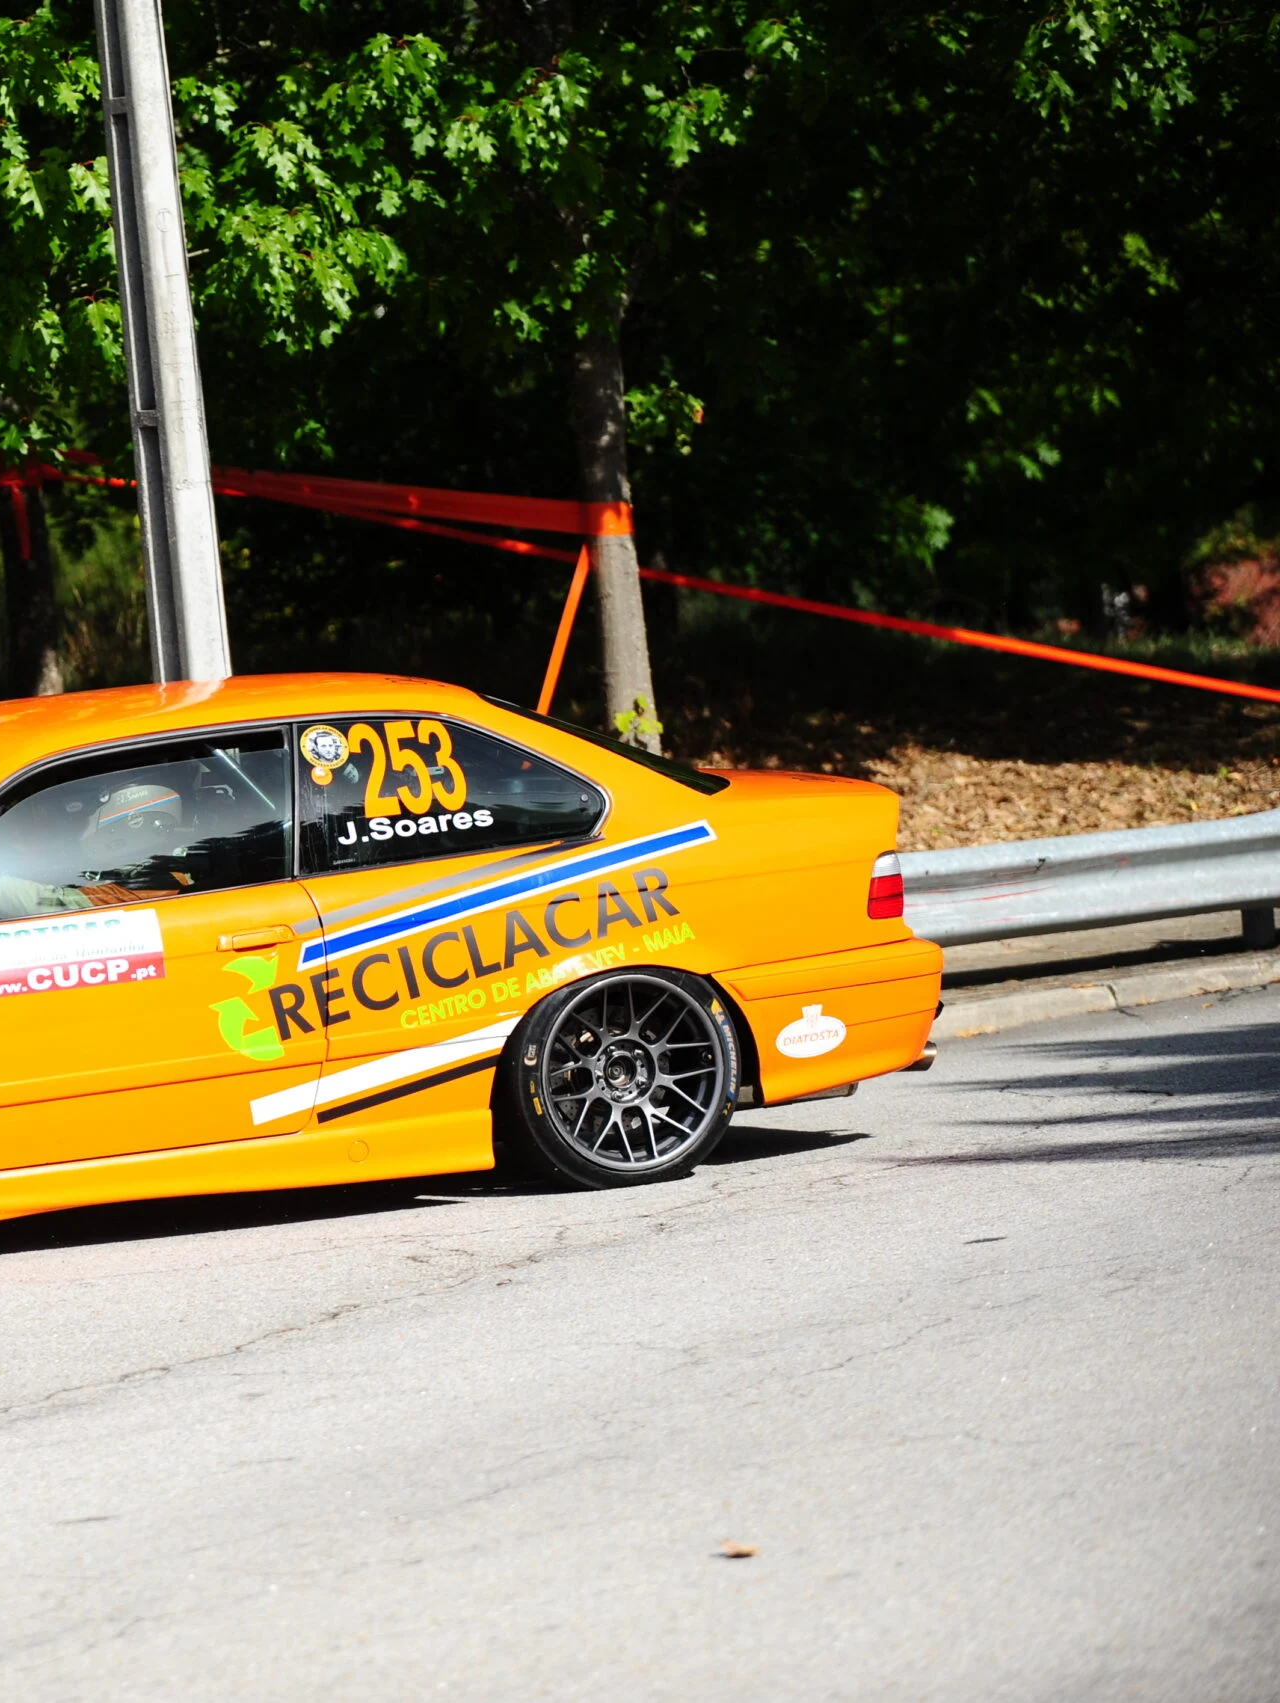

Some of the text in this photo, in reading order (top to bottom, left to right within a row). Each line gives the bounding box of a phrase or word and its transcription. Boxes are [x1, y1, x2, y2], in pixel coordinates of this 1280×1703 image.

[347, 719, 467, 819] 253
[337, 809, 494, 845] J.Soares
[268, 867, 681, 1041] RECICLACAR
[400, 989, 487, 1029] CENTRO
[491, 980, 522, 1003] DE
[587, 943, 627, 968] VFV
[641, 922, 696, 952] MAIA
[722, 1024, 737, 1094] MICHELIN
